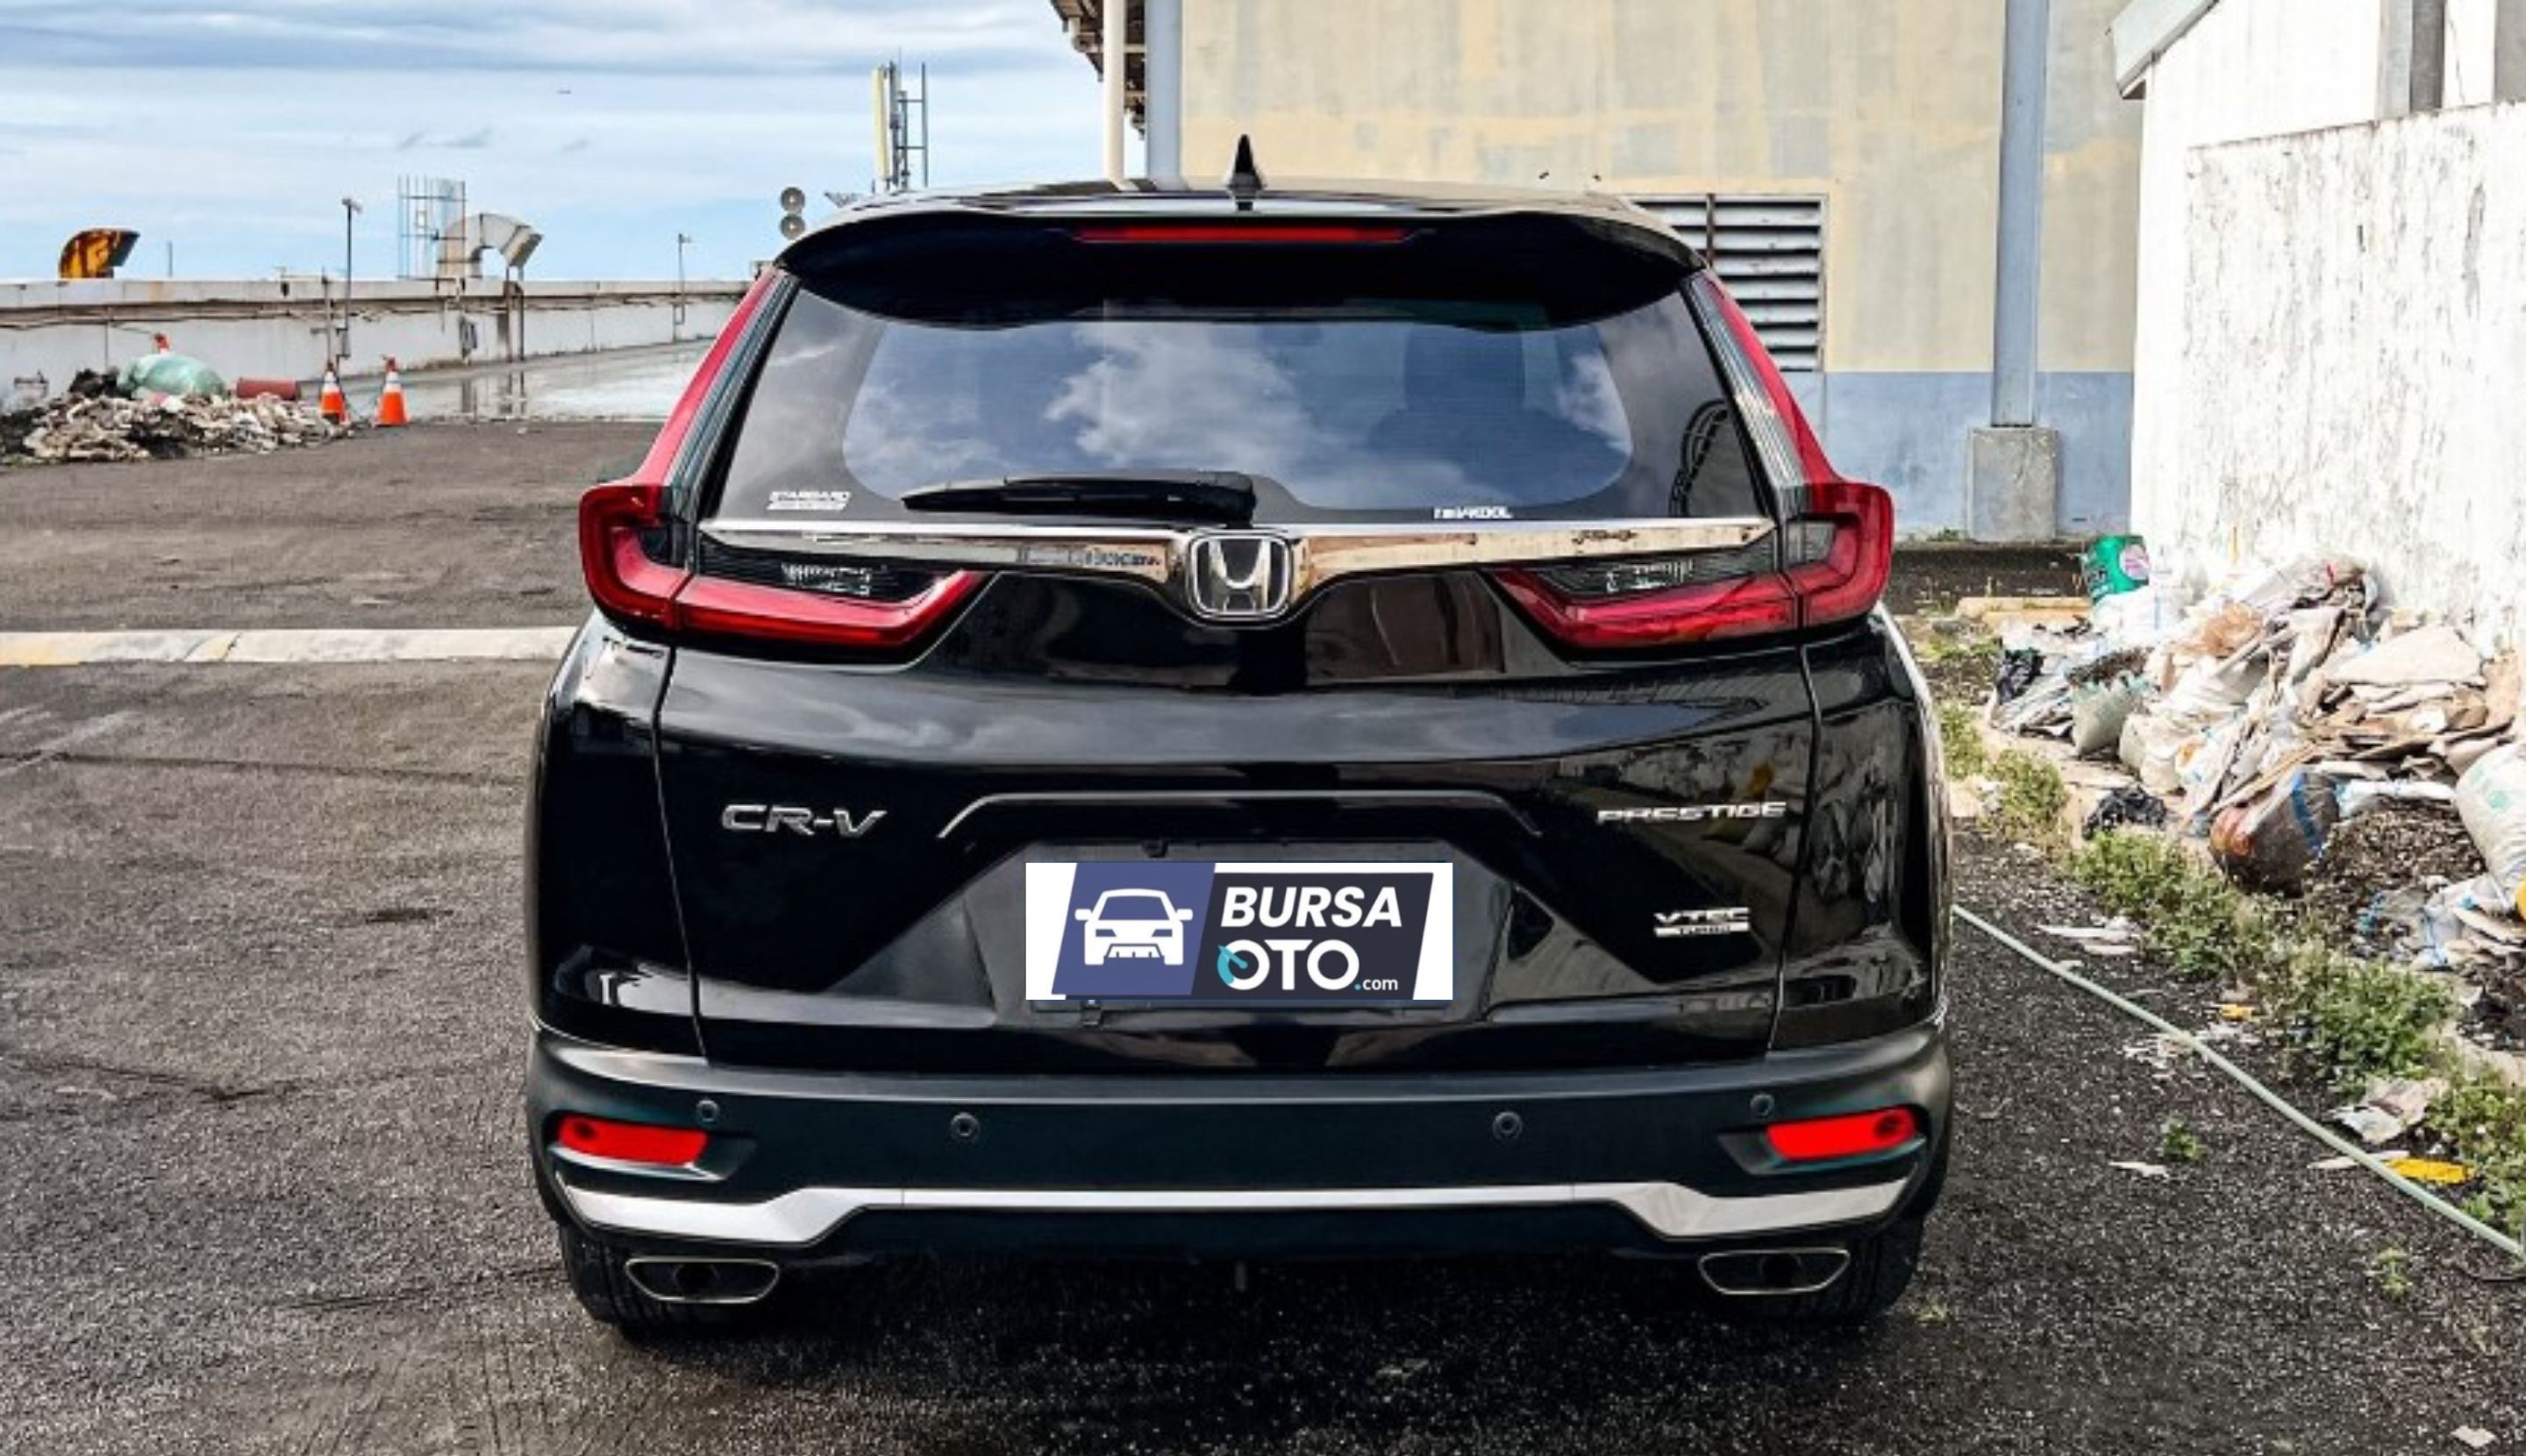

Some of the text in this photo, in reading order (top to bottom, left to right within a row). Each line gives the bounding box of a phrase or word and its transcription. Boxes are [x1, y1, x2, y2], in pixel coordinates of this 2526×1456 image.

[722, 804, 888, 837] CR-V
[1597, 802, 1787, 824] PRESTIGE
[1654, 907, 1750, 924] VTEC
